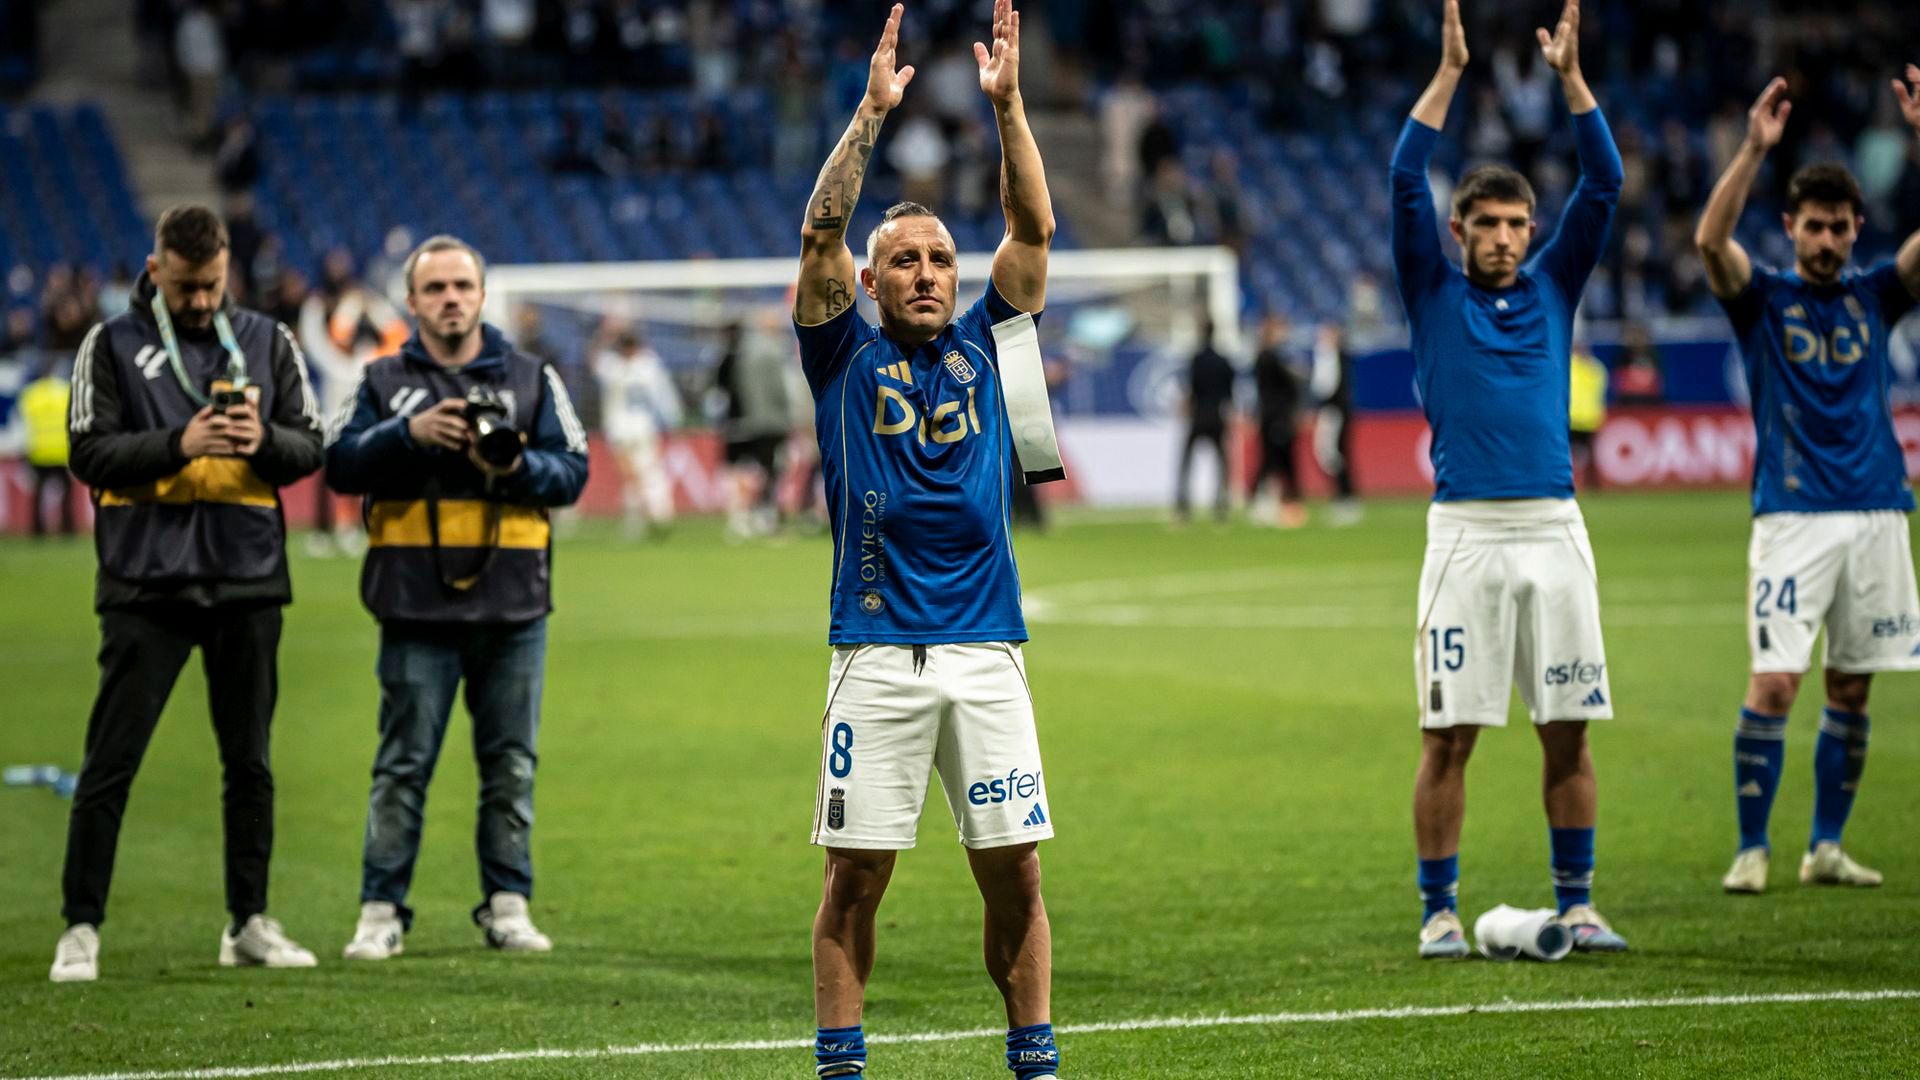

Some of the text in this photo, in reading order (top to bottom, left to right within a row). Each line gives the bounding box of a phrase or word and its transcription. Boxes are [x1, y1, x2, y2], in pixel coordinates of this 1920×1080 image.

[1784, 324, 1870, 366] DIGI
[873, 386, 981, 447] DIGI
[860, 490, 878, 582] OVIEDO
[1755, 576, 1797, 618] 24
[1872, 612, 1920, 639] esfe
[1429, 627, 1465, 672] 15
[829, 722, 853, 778] 8
[968, 767, 1041, 805] esfer
